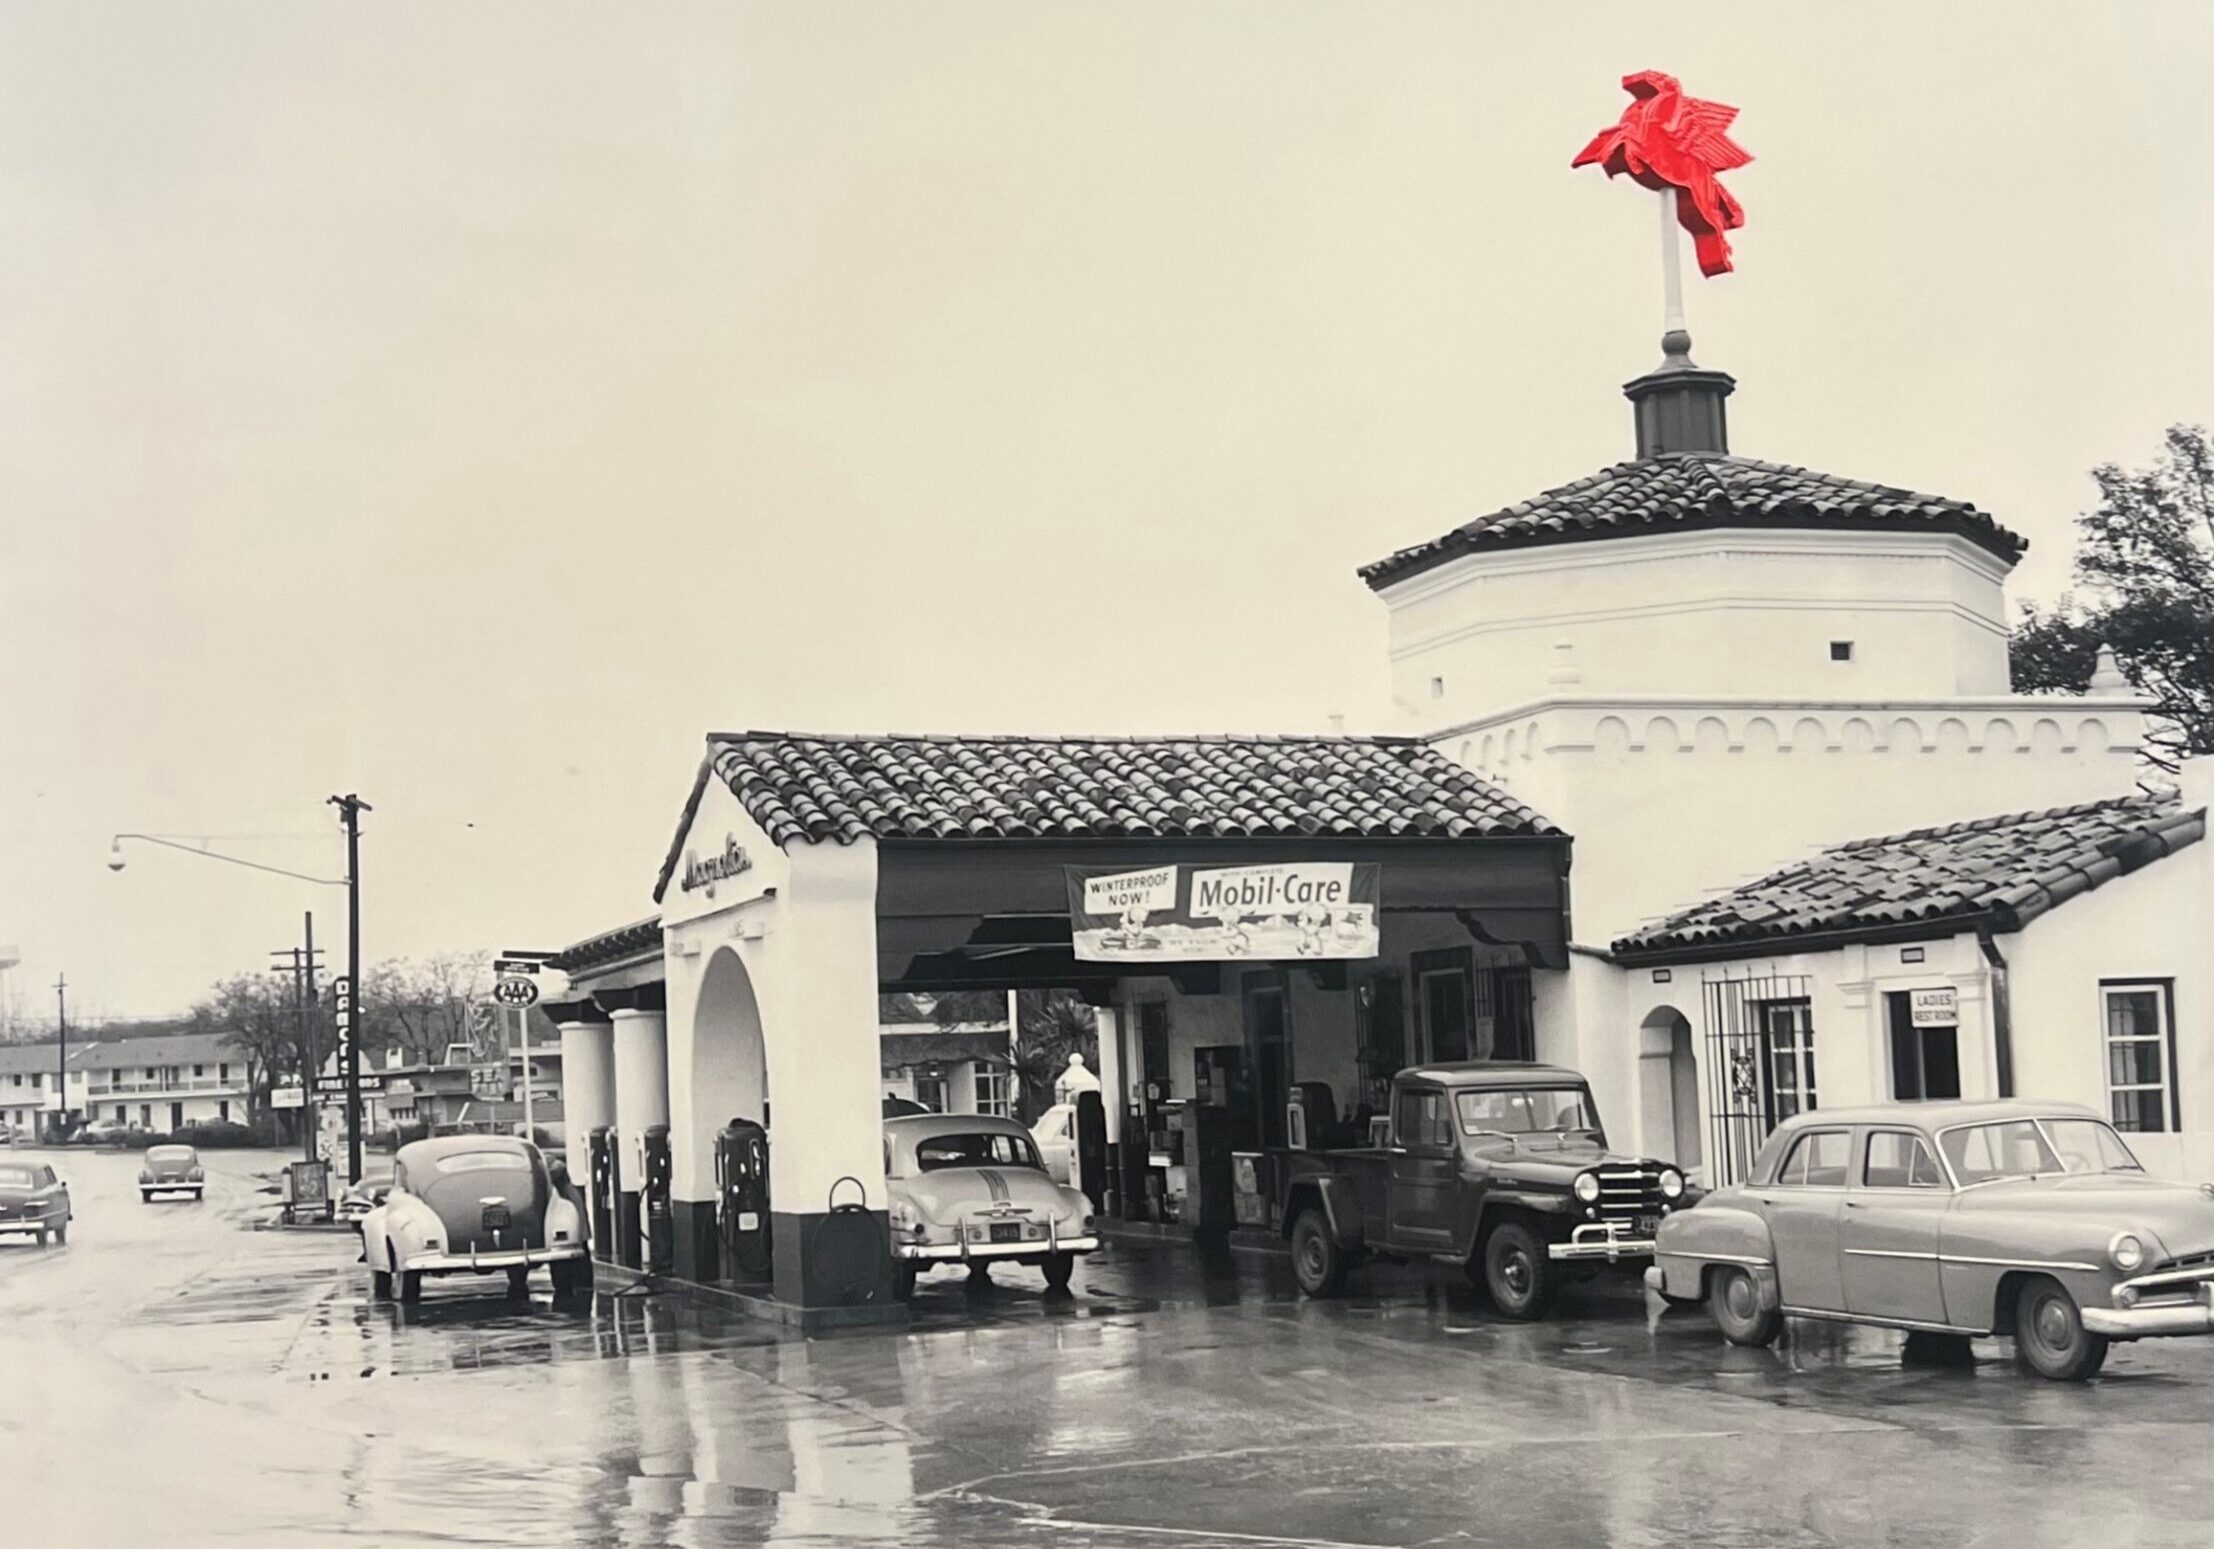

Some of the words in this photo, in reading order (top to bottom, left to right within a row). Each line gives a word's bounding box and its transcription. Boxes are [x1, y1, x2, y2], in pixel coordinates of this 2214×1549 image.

[1090, 872, 1169, 893] WINTERPROOF
[503, 981, 529, 1003] AAA
[1916, 994, 1952, 1007] LADIES
[1914, 1010, 1933, 1022] REST
[1934, 1009, 1958, 1021] ROOM
